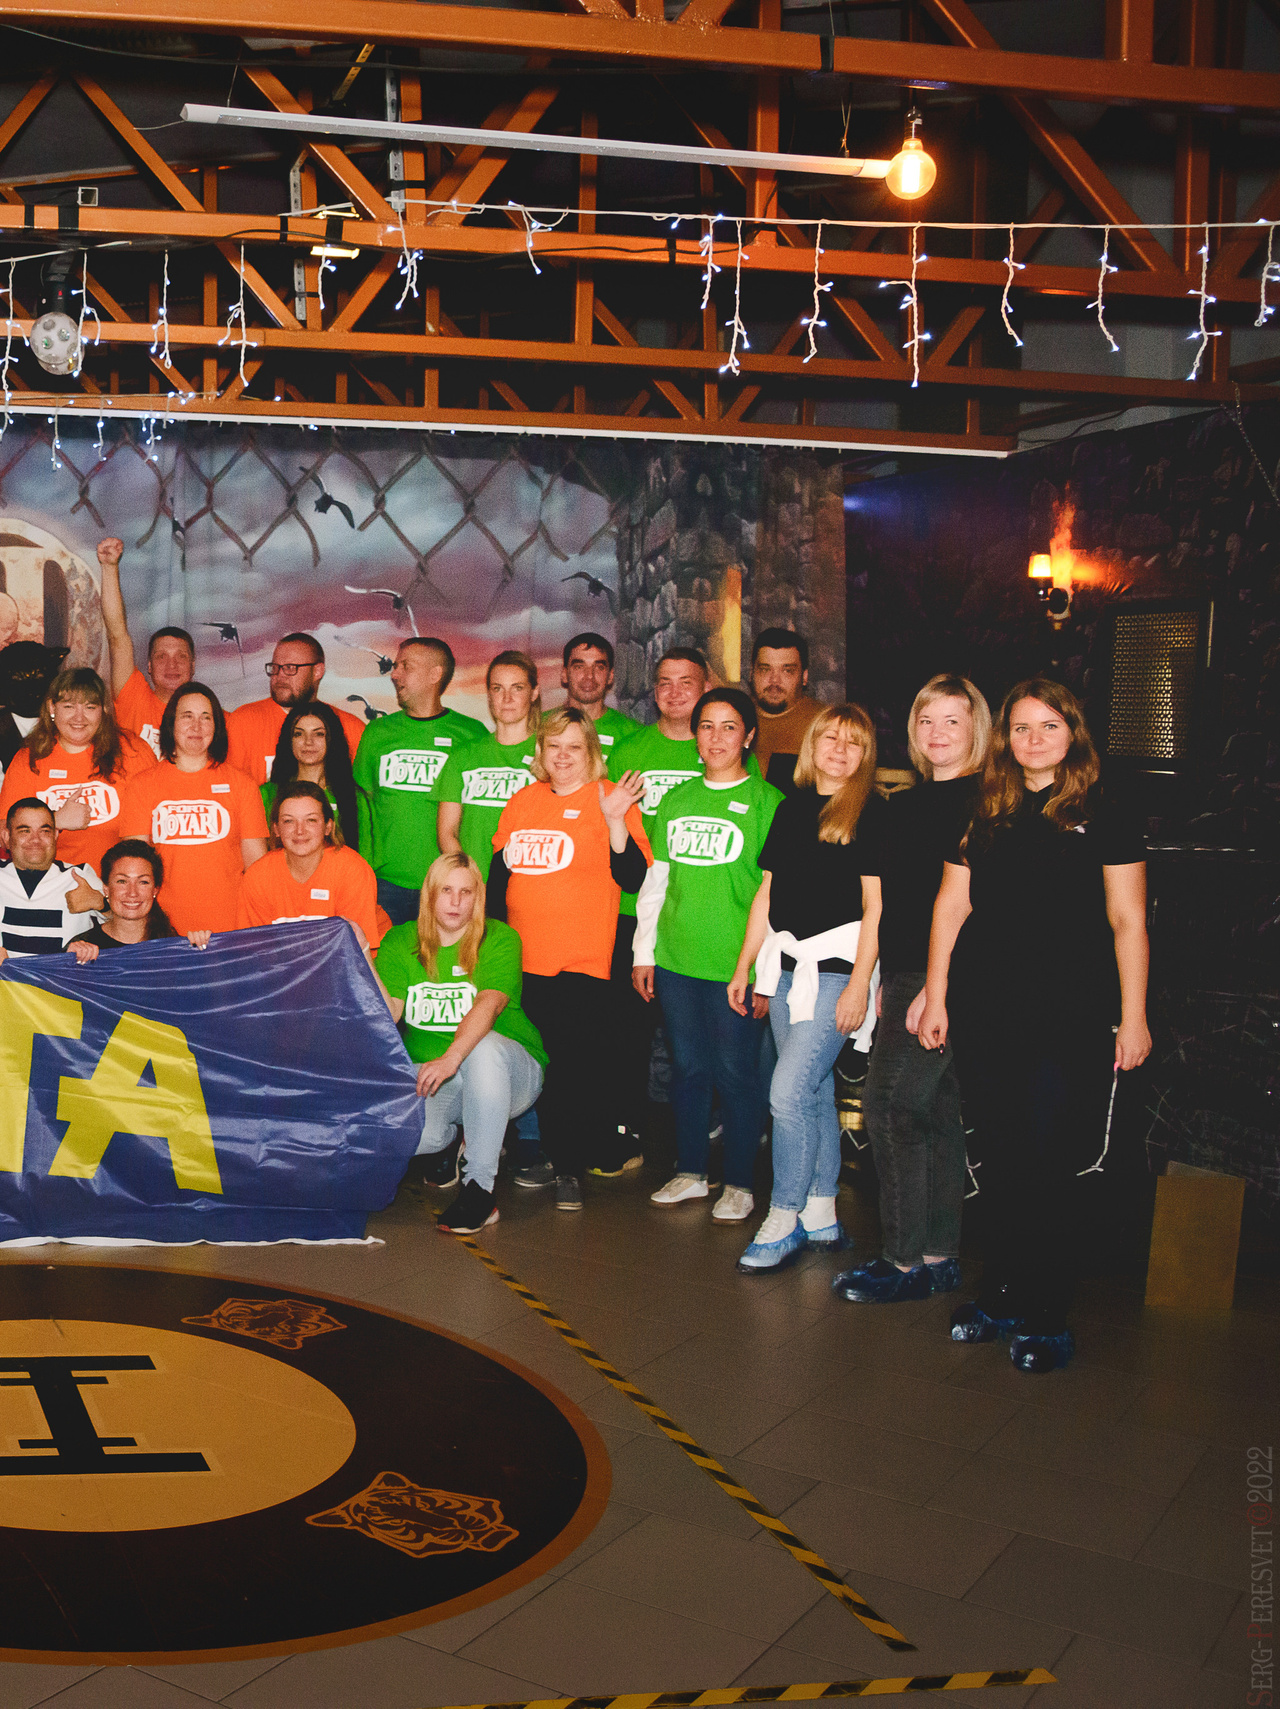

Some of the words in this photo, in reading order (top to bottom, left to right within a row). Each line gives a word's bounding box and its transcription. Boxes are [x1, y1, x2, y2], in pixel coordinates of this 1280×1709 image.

[399, 754, 439, 765] FORT
[379, 754, 446, 788] BOYAR
[480, 772, 518, 780] FORT
[167, 804, 207, 814] FORT
[152, 804, 230, 843] BOYARD
[684, 821, 722, 833] FORT
[667, 820, 744, 863] BOYARD
[423, 988, 462, 999] FORT
